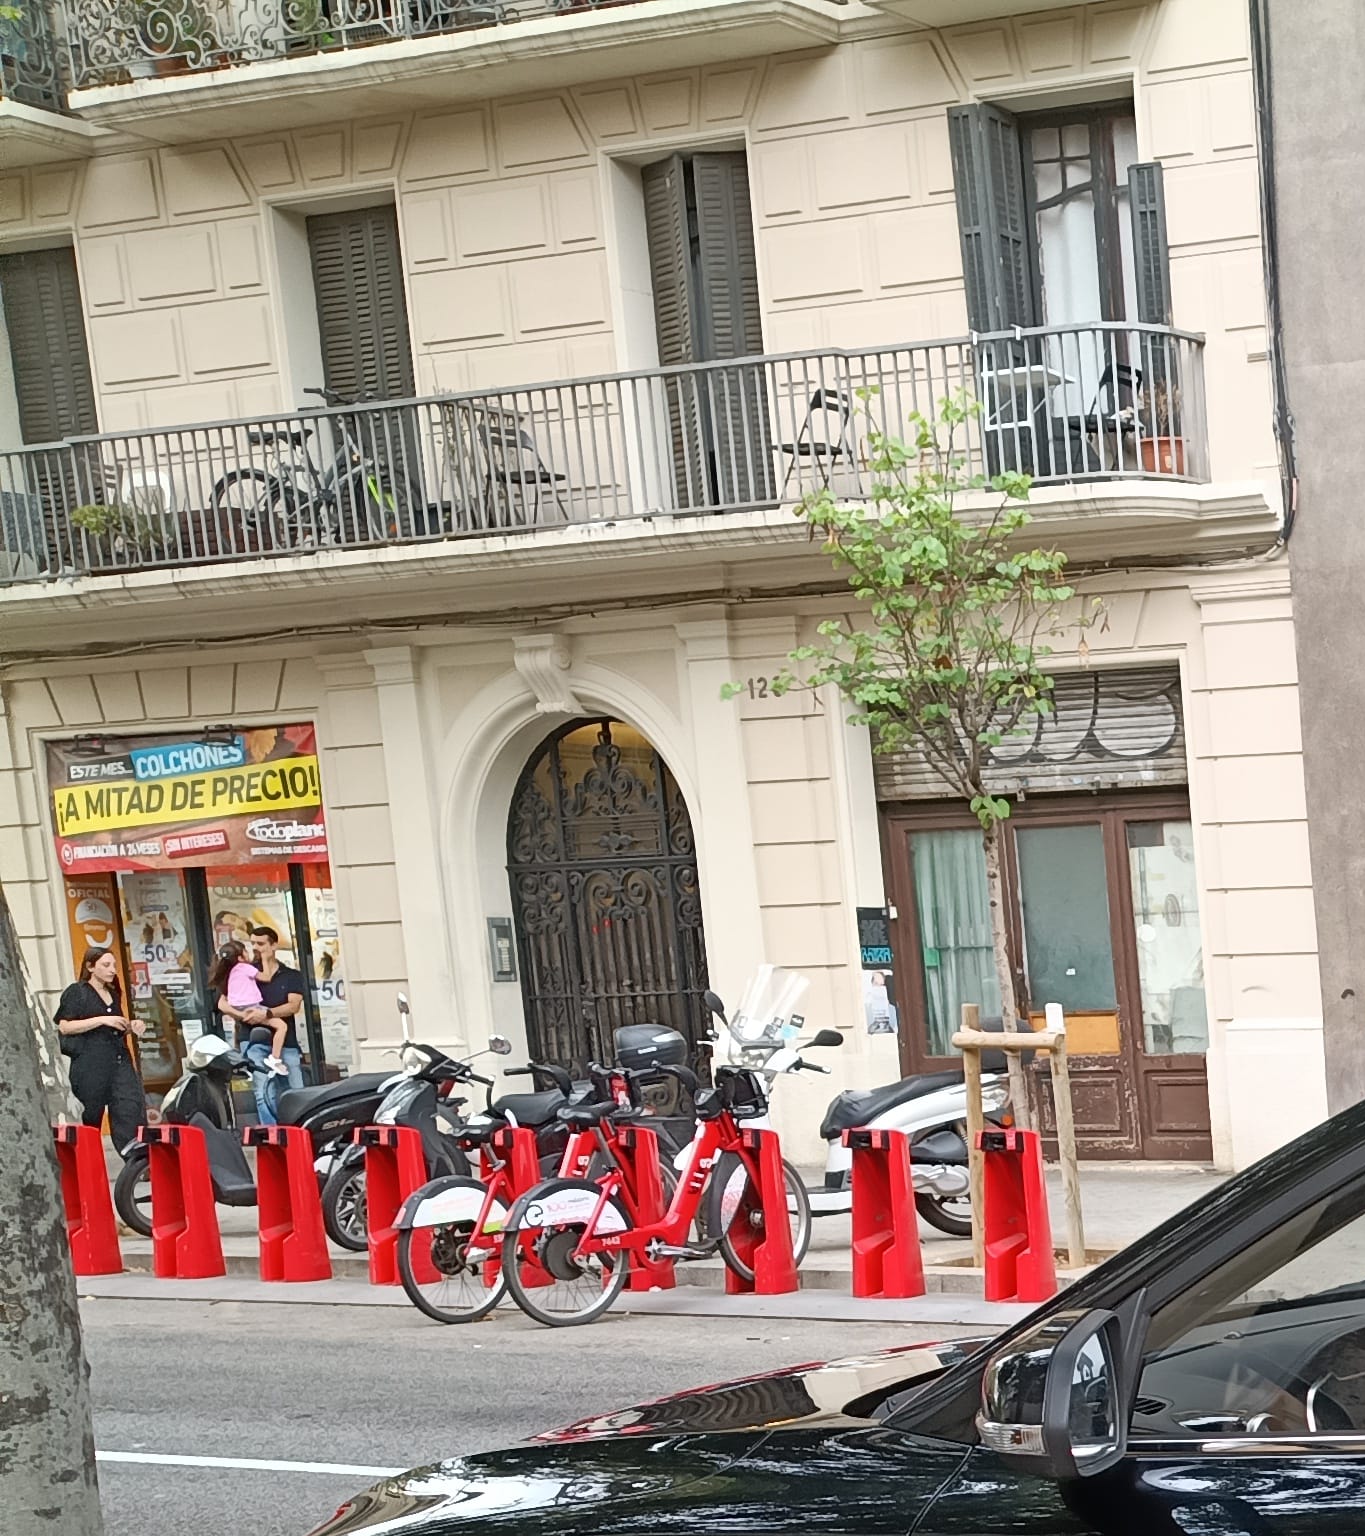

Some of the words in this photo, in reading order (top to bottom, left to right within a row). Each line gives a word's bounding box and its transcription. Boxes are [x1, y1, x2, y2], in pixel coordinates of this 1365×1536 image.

[70, 763, 100, 779] ESTE
[135, 743, 243, 779] COLCHONES
[59, 792, 80, 832] ¡A
[84, 784, 165, 820] MITAD
[171, 779, 206, 811] DE
[212, 765, 318, 807] PRECIO!
[68, 888, 111, 899] OFICIAL
